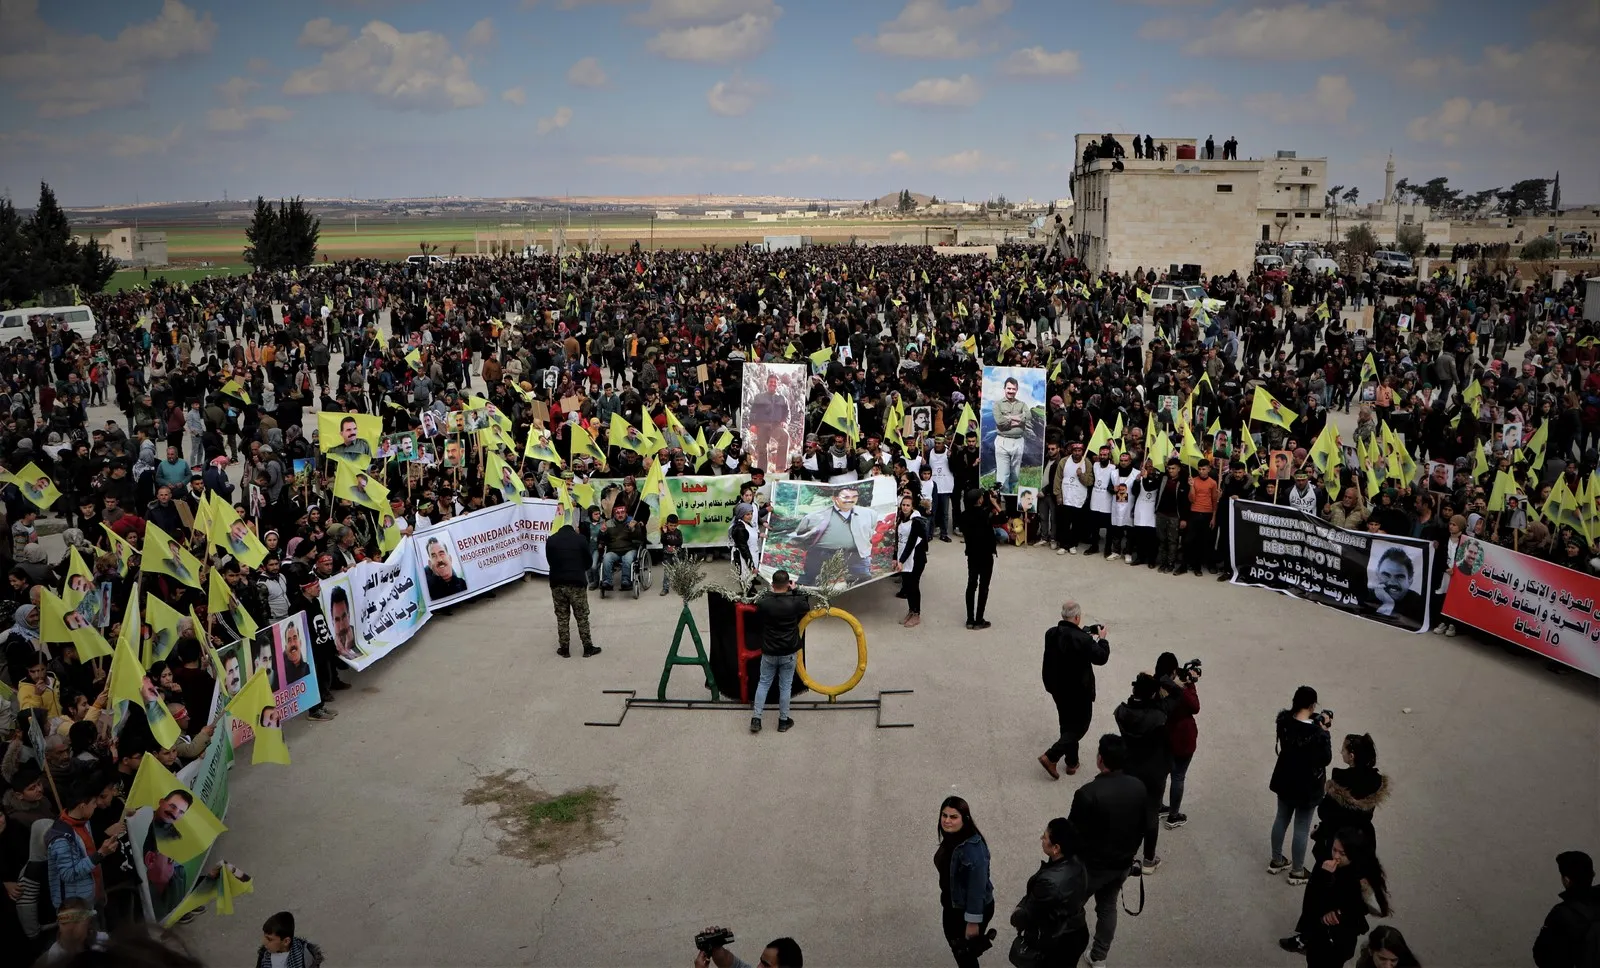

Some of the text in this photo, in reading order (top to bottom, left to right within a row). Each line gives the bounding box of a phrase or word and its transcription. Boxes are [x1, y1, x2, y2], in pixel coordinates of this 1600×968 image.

[457, 524, 513, 550] BERXWEDANA
[1259, 526, 1279, 538] DEM
[1256, 556, 1280, 569] شباط
[1263, 540, 1341, 570] RÊBER APO YE
[1283, 560, 1293, 569] ١٥
[1295, 562, 1323, 580] مؤامرة
[1250, 567, 1274, 580] APO
[1278, 570, 1300, 586] القائد
[1482, 564, 1513, 585] الخيانة
[1301, 576, 1321, 592] حرية
[1469, 579, 1509, 605] مؤامرة
[1323, 587, 1342, 601] وقت
[1559, 590, 1593, 613] للعزلة
[1550, 609, 1590, 634] الحرية
[1514, 618, 1560, 645] ١٥ شباط
[290, 682, 306, 698] APO
[288, 701, 299, 714] YE
